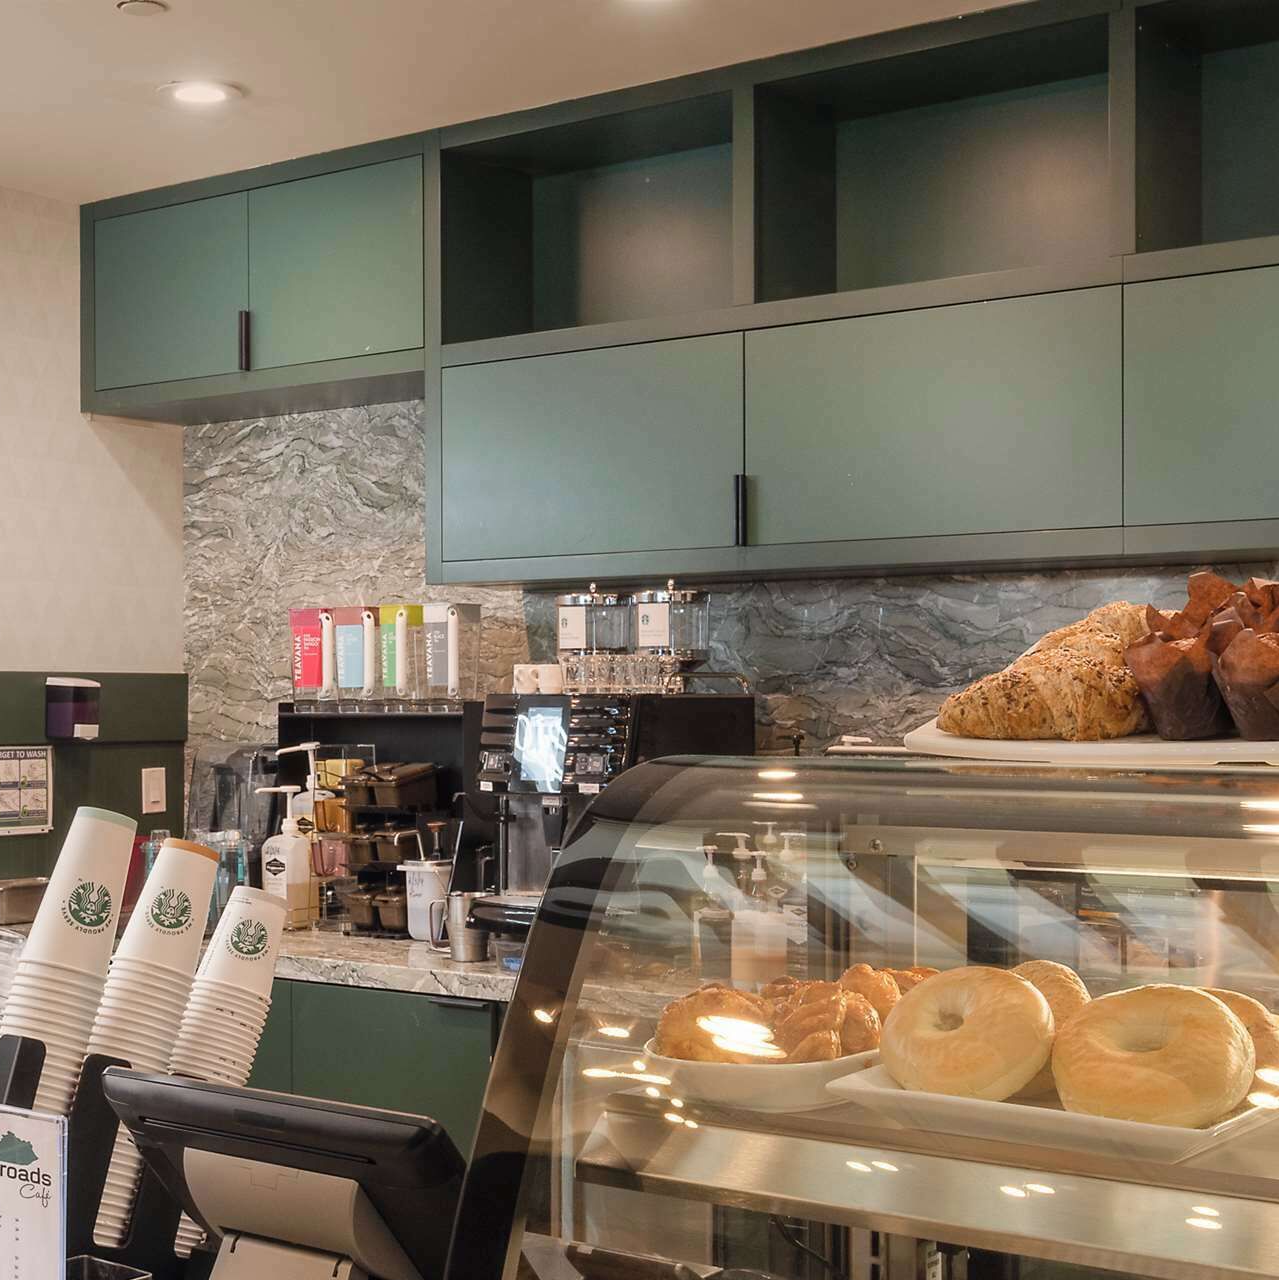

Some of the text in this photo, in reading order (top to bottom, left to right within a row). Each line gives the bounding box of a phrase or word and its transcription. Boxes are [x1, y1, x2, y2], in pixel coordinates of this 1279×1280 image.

[294, 635, 302, 681] TEAVANA
[16, 751, 25, 759] TO
[26, 750, 46, 758] WASH
[74, 925, 105, 935] PROUDLY
[155, 928, 184, 936] PROUDLY
[19, 1183, 51, 1208] Café
